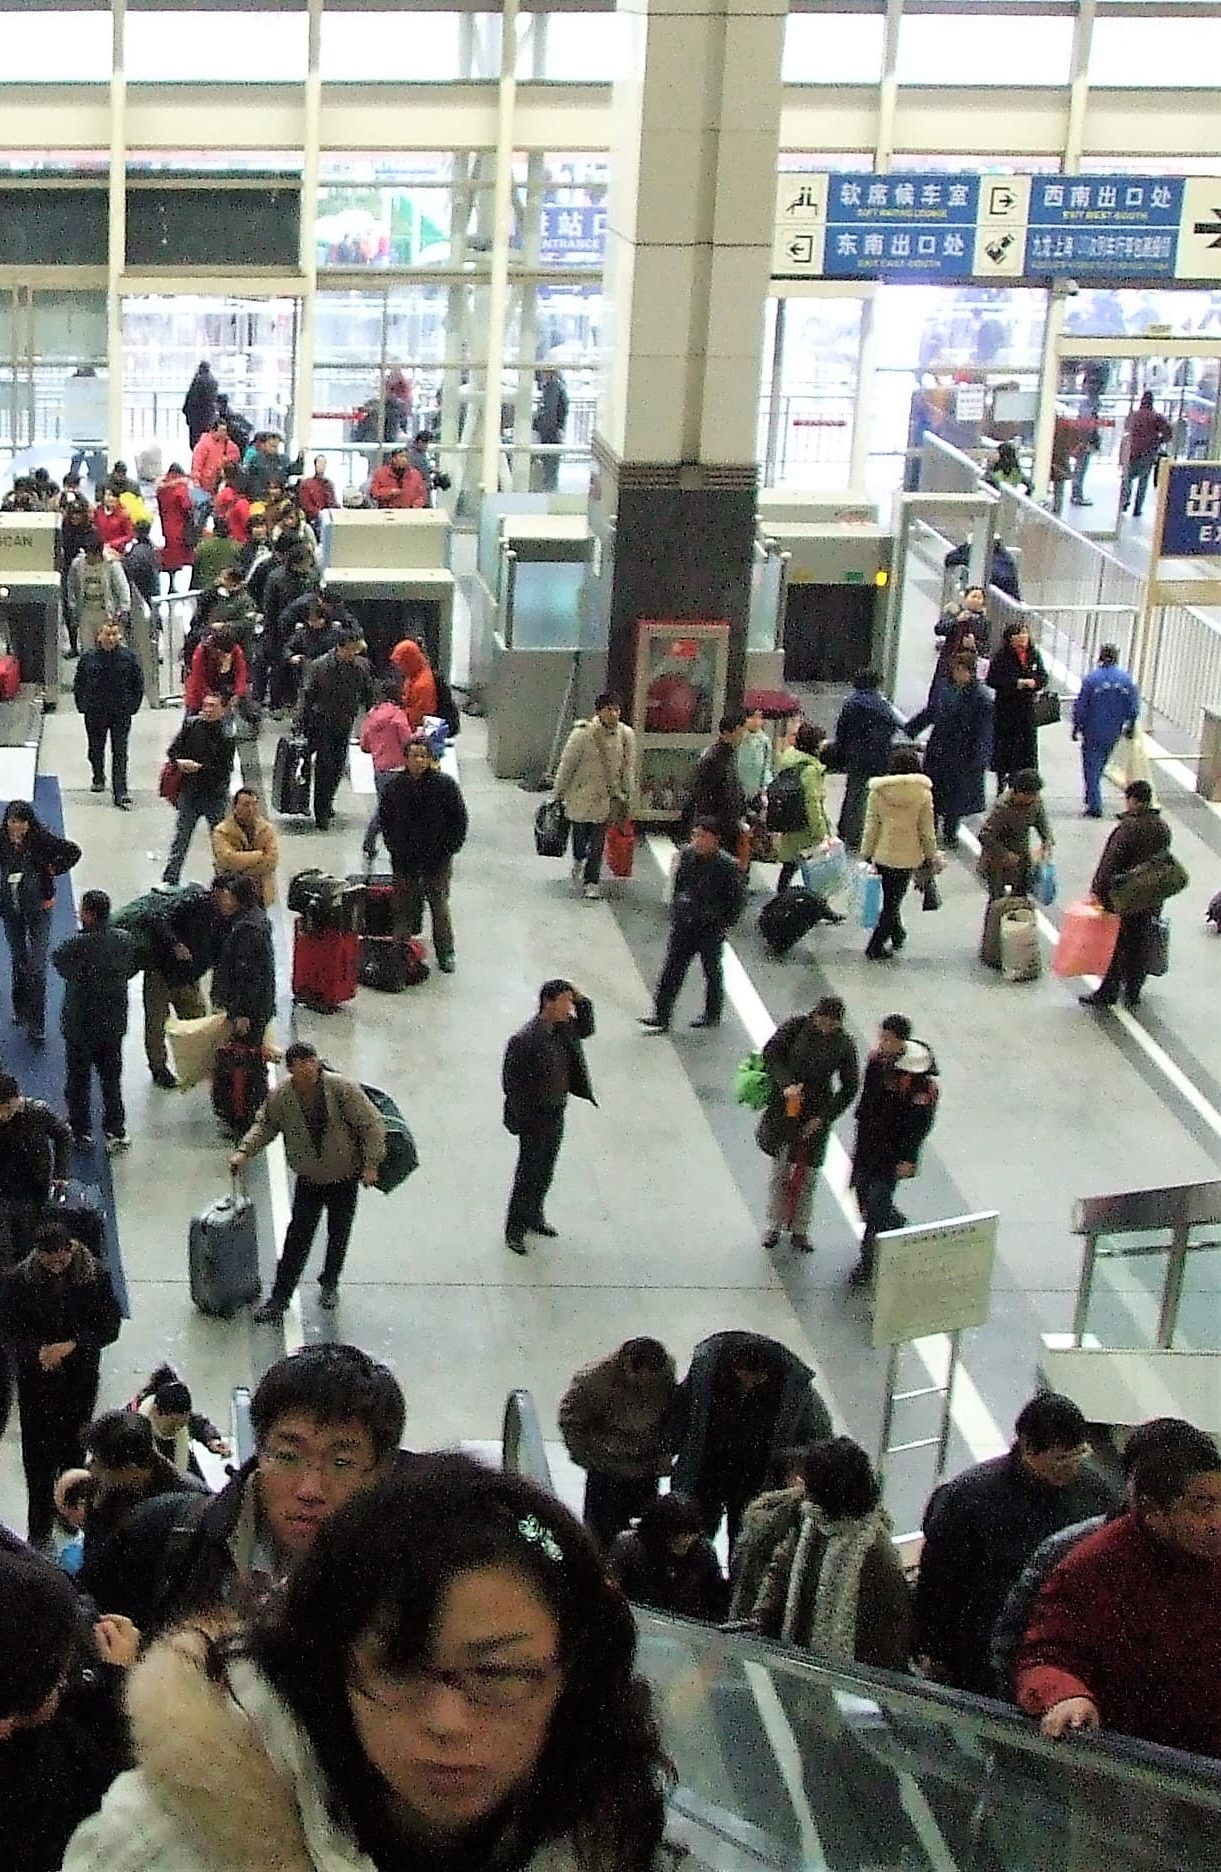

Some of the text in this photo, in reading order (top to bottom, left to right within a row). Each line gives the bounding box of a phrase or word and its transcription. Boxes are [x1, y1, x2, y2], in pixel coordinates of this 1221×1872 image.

[840, 182, 970, 206] 软席候车室
[1043, 185, 1173, 208] 西南出口处
[837, 233, 965, 256] 东南出口处
